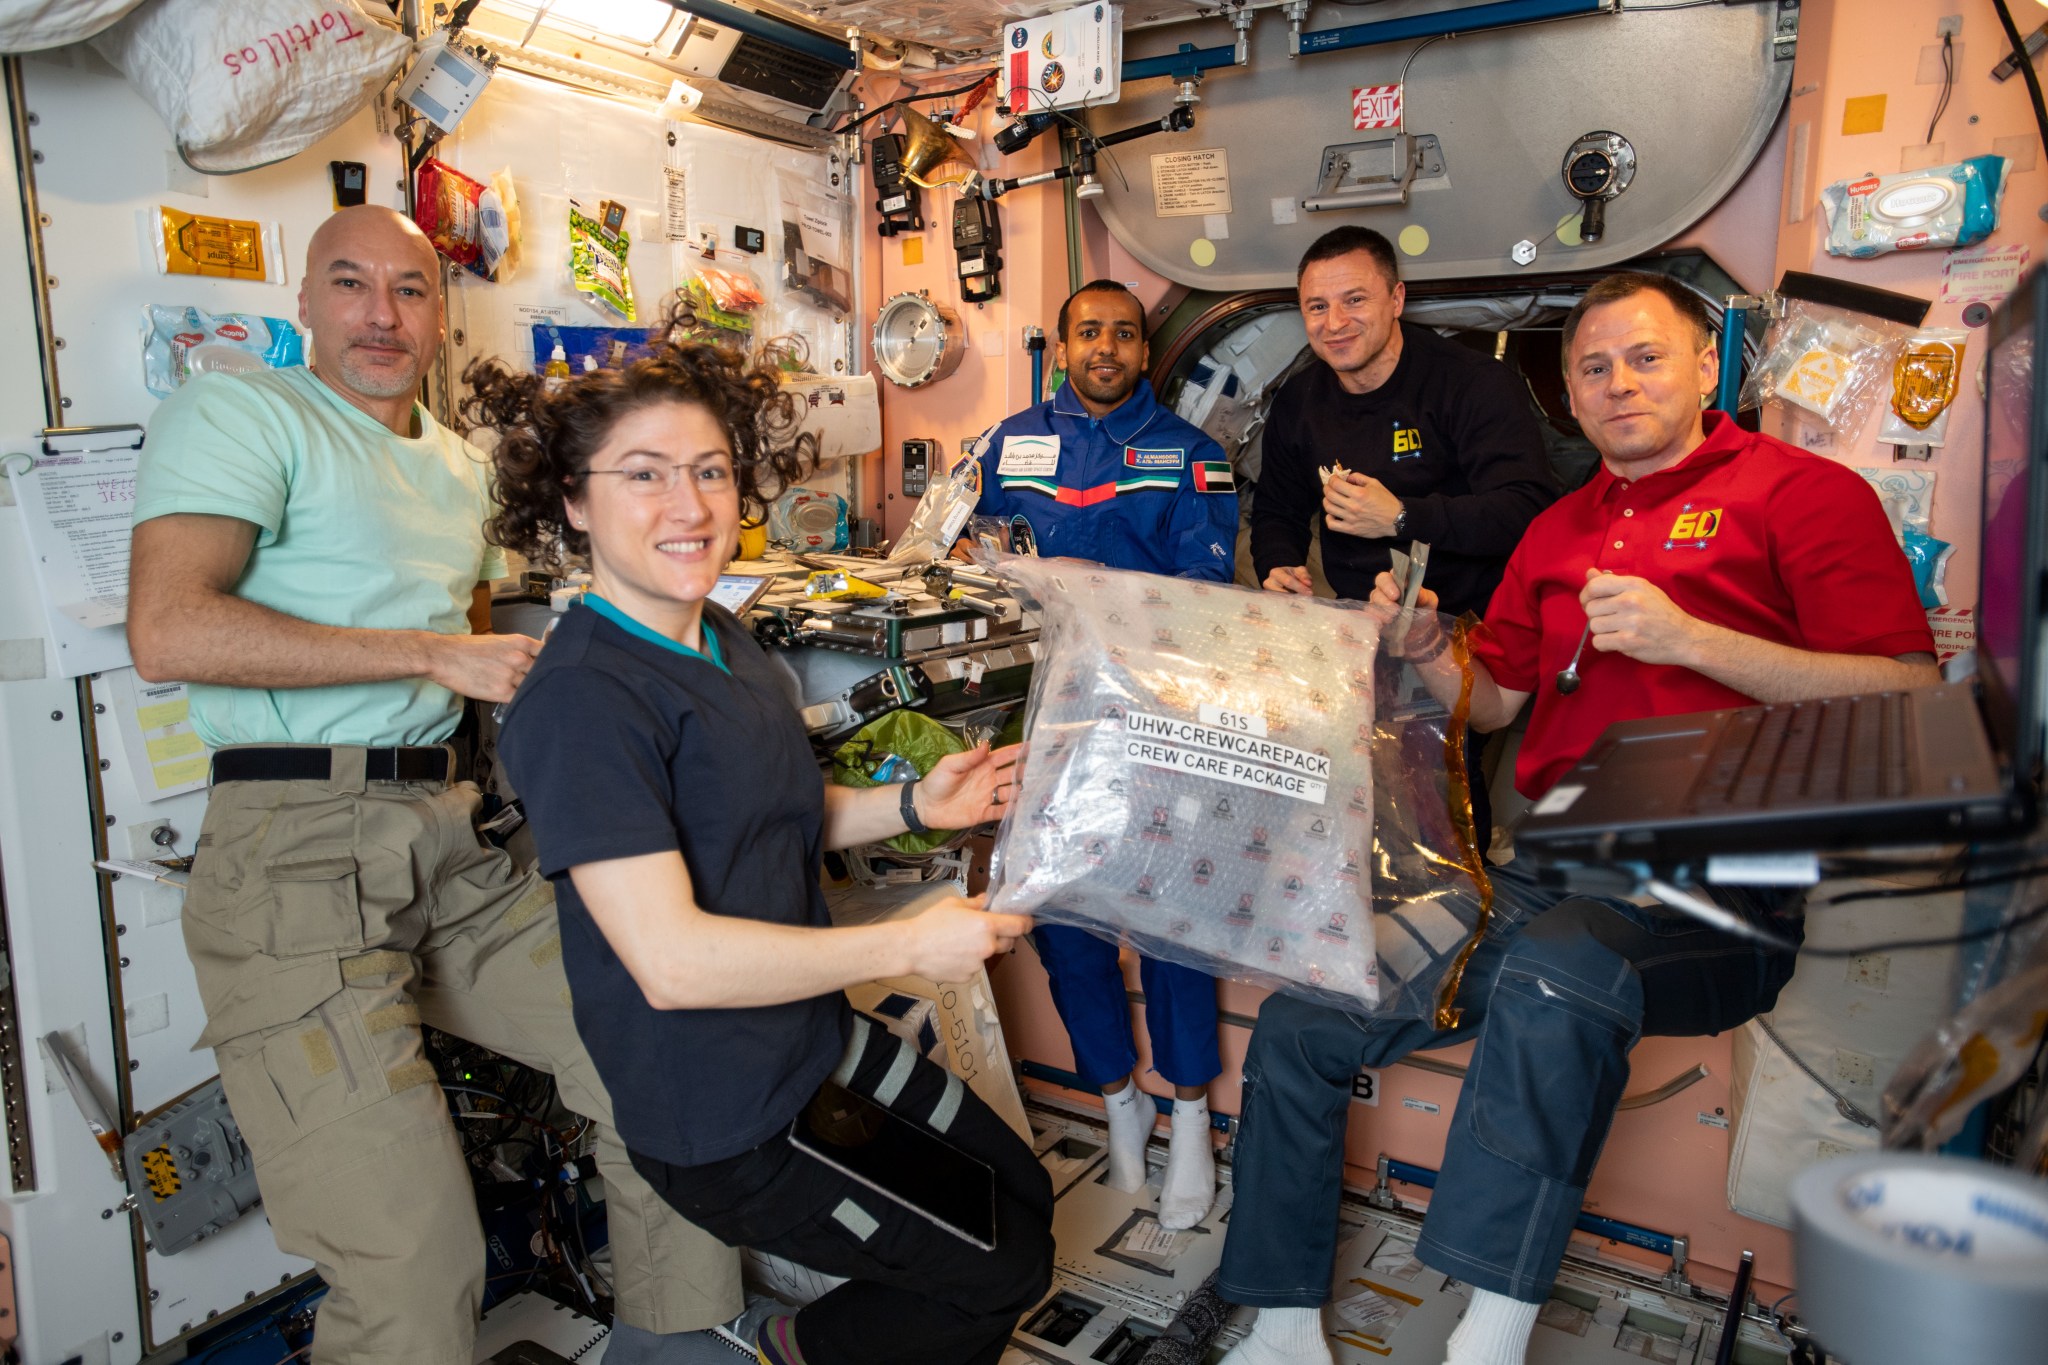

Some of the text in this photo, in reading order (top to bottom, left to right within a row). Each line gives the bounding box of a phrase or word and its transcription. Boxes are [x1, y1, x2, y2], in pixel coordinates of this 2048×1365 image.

[223, 10, 364, 75] Tortillas
[1360, 96, 1393, 120] EXIT
[1952, 256, 2001, 265] EMERGENCY
[1952, 268, 2017, 280] FIRE PORT
[1805, 432, 1835, 448] WET
[1669, 508, 1723, 539] 60
[1927, 616, 1973, 624] EMERGENCY
[1932, 629, 1977, 640] IRE PO
[1935, 643, 1970, 651] NOD1P4-
[1220, 711, 1249, 731] 61S
[1127, 714, 1330, 776] UHW-CREWCAREPACK
[1127, 742, 1181, 765] CREW
[1184, 753, 1229, 776] CARE
[1232, 764, 1306, 795] PACKAGE
[1310, 782, 1323, 791] QTY
[1351, 1073, 1374, 1100] B
